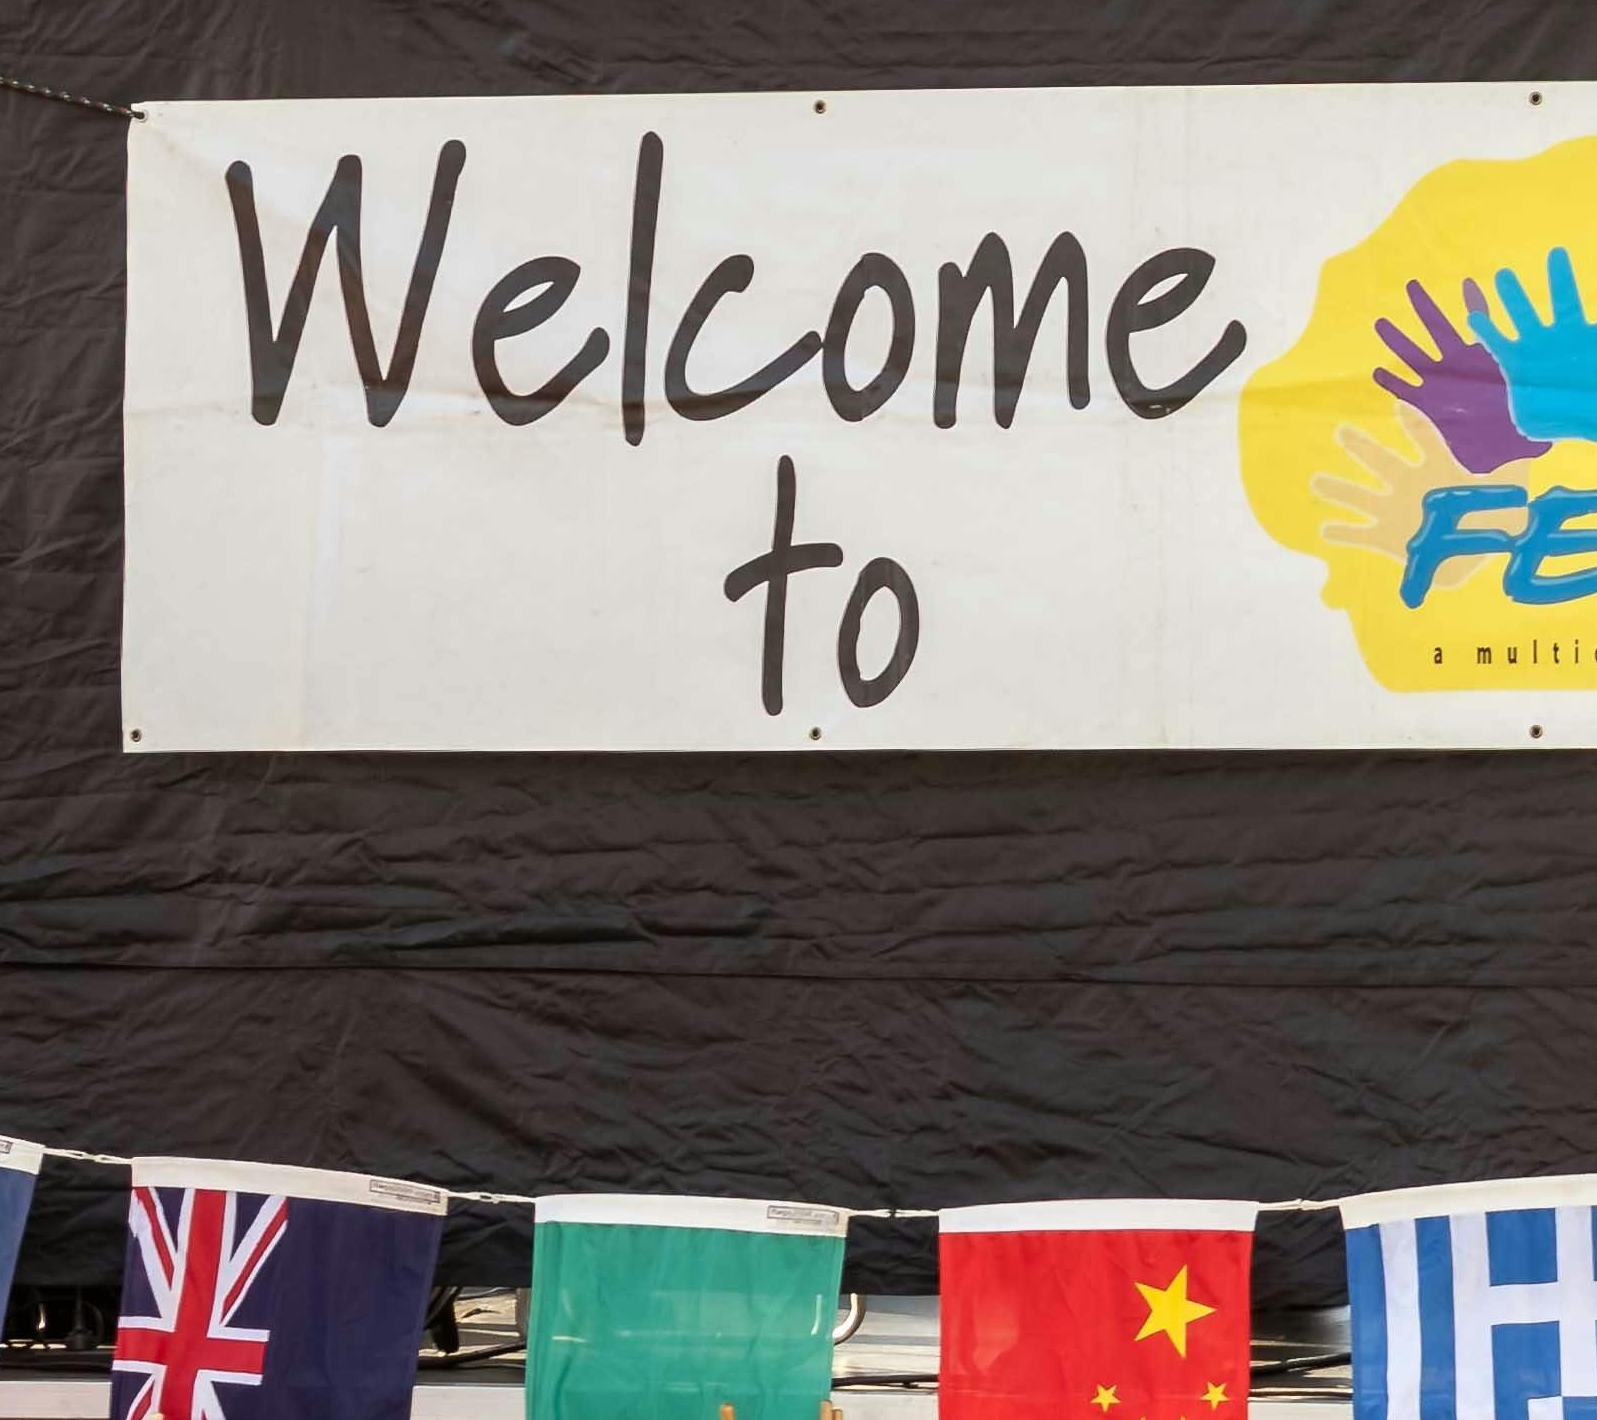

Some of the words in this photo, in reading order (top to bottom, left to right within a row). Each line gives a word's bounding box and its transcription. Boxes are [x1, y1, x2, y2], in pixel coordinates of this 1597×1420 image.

[224, 130, 1248, 447] Welcome
[723, 454, 921, 717] to
[1433, 645, 1444, 665] a
